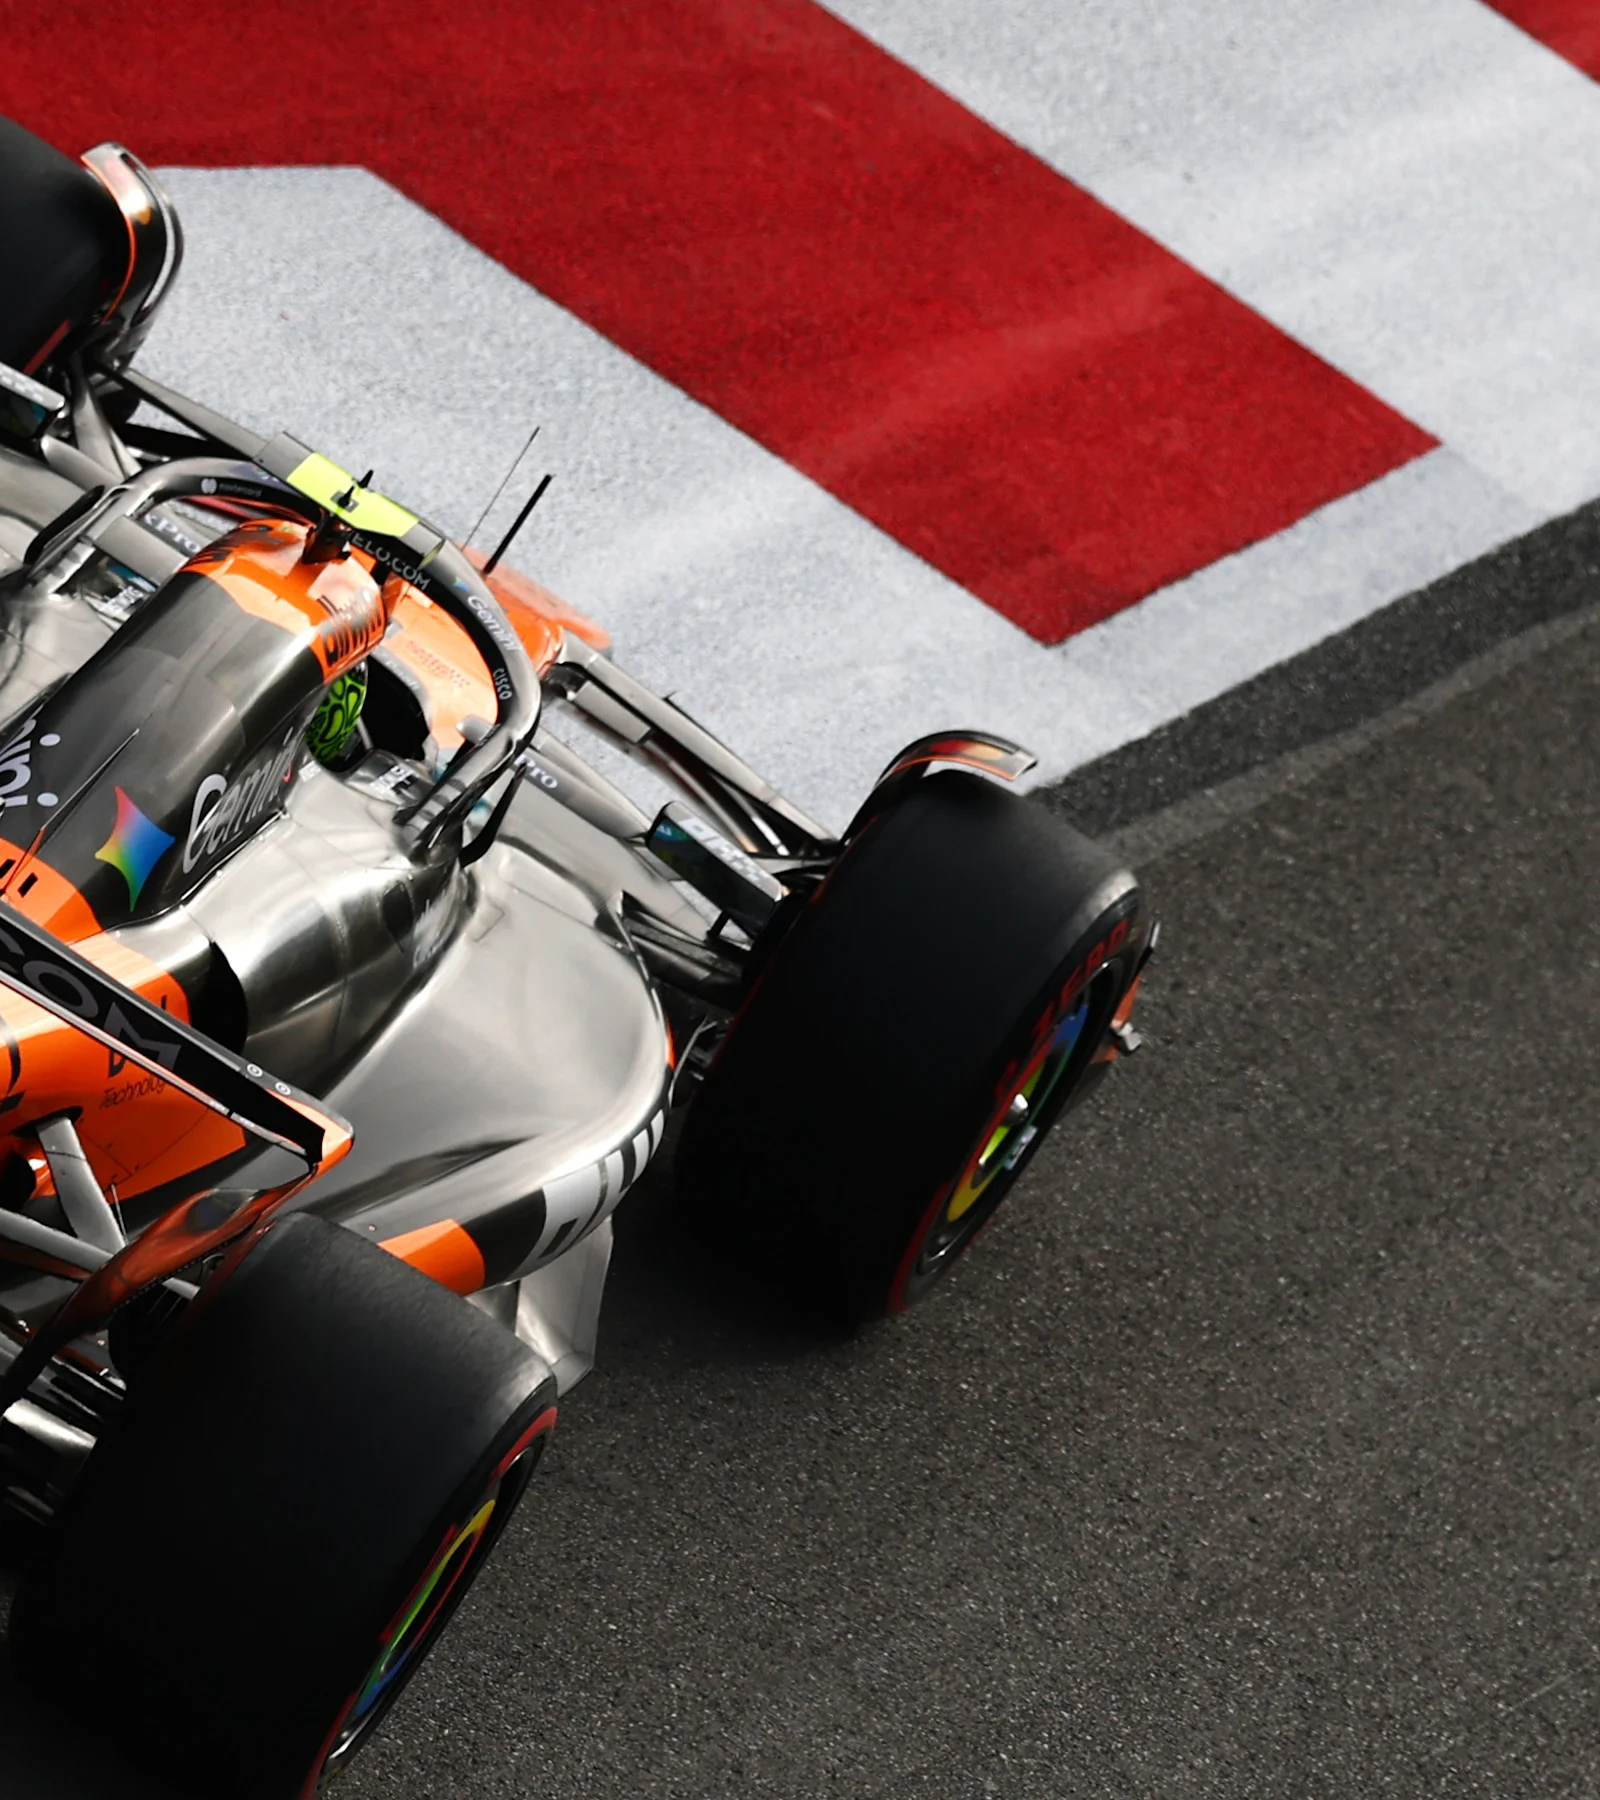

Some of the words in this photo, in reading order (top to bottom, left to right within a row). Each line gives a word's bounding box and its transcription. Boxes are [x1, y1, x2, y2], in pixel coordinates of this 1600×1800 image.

[351, 532, 431, 591] ELO.COM
[466, 594, 523, 652] Gemini
[513, 752, 558, 790] Pro
